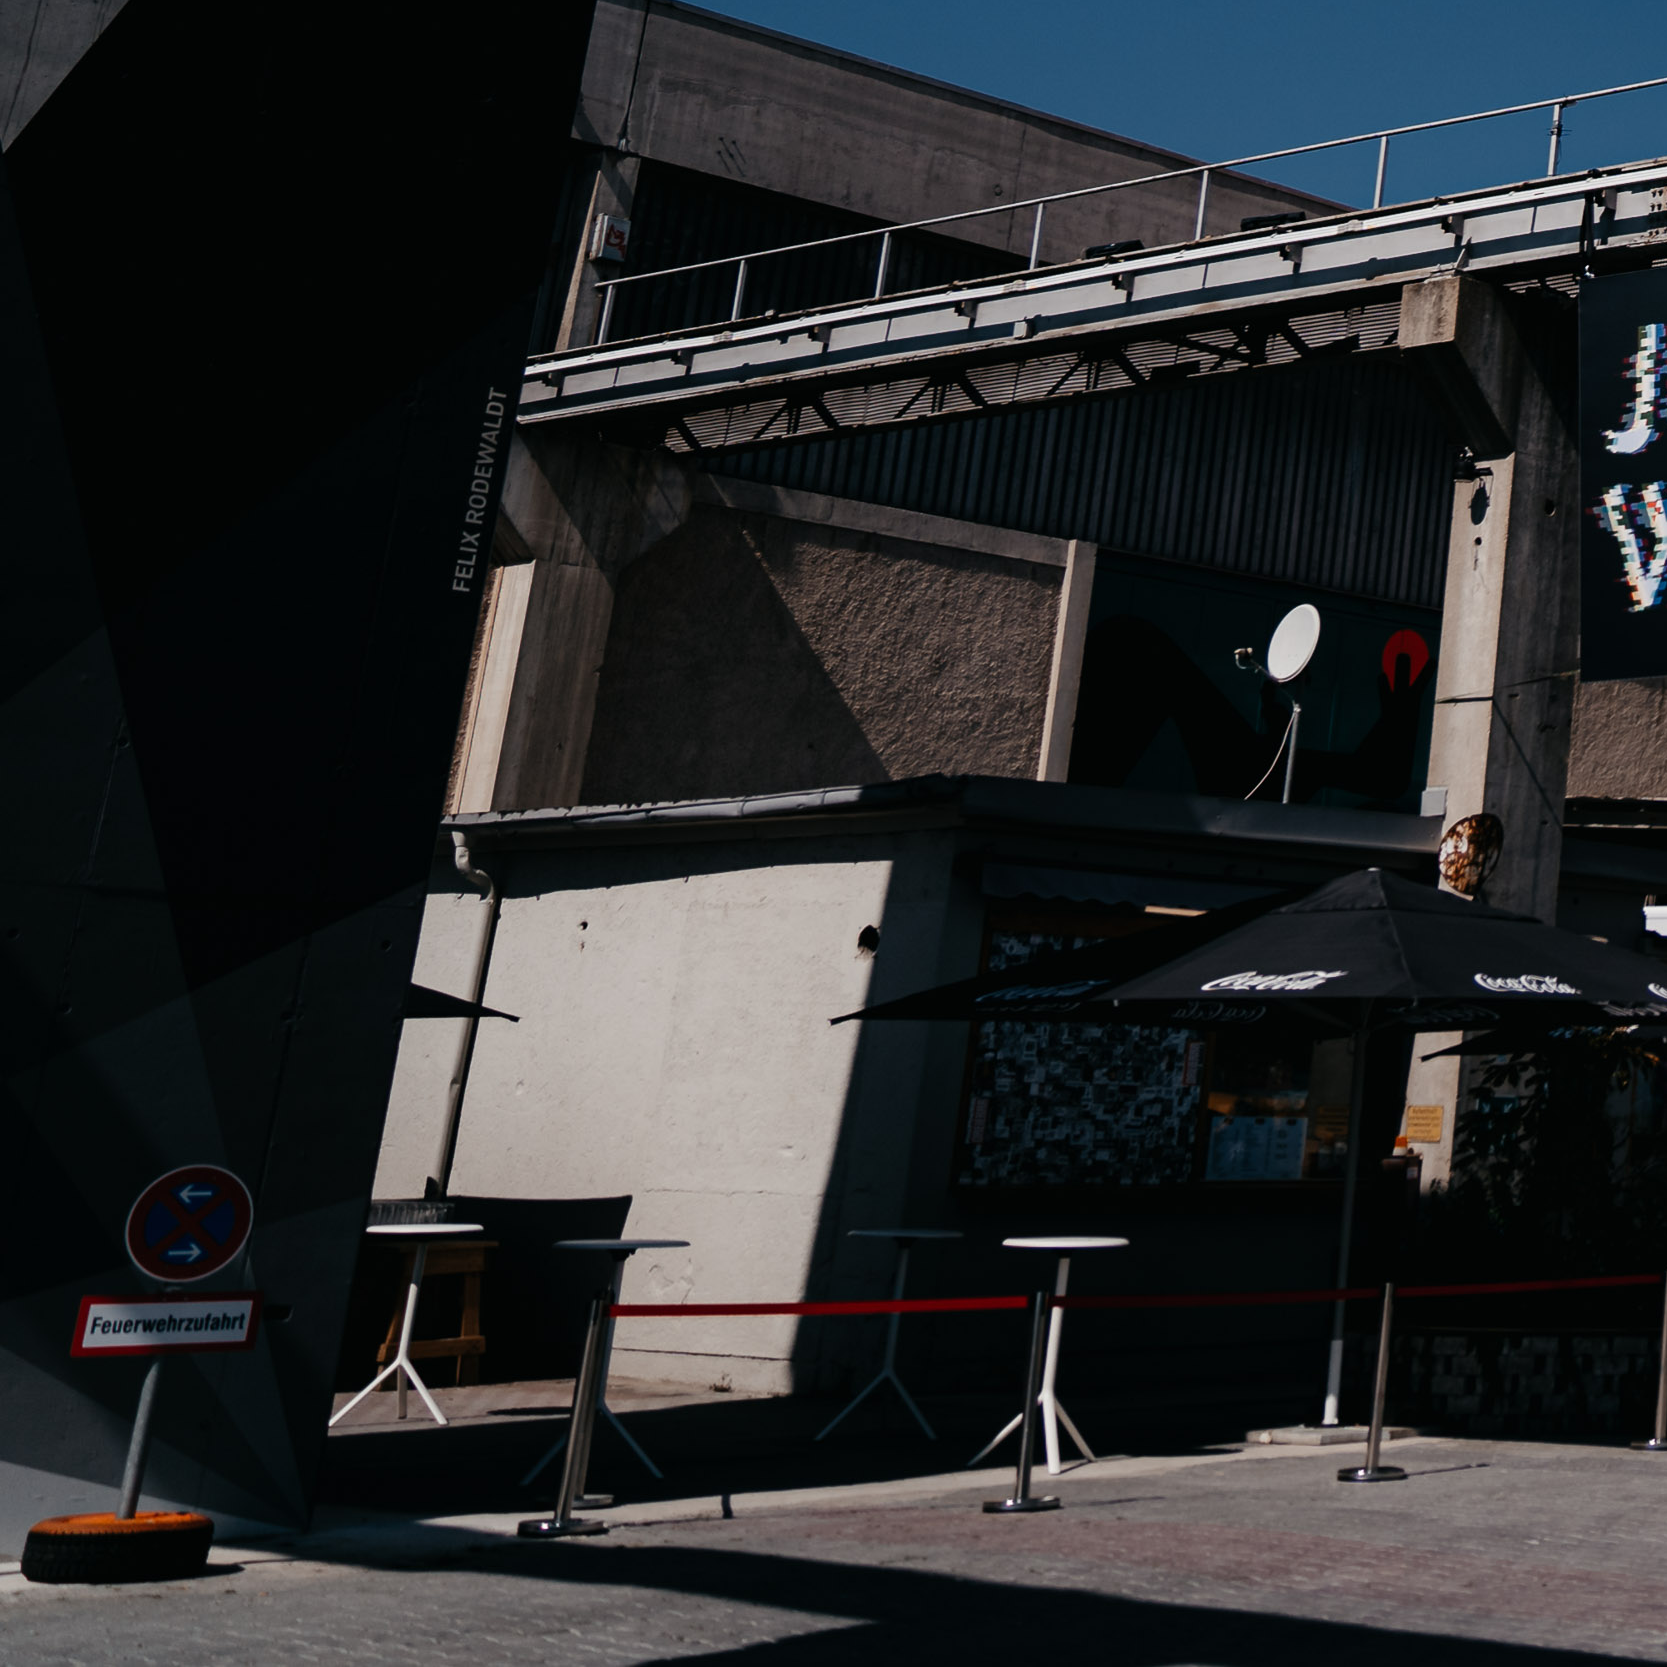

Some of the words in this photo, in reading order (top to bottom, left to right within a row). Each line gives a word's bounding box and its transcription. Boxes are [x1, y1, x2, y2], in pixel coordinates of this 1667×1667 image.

[465, 386, 508, 525] RODEWALDT
[452, 530, 481, 593] FELIX
[91, 1313, 245, 1334] Feuerwehrzufahrt
